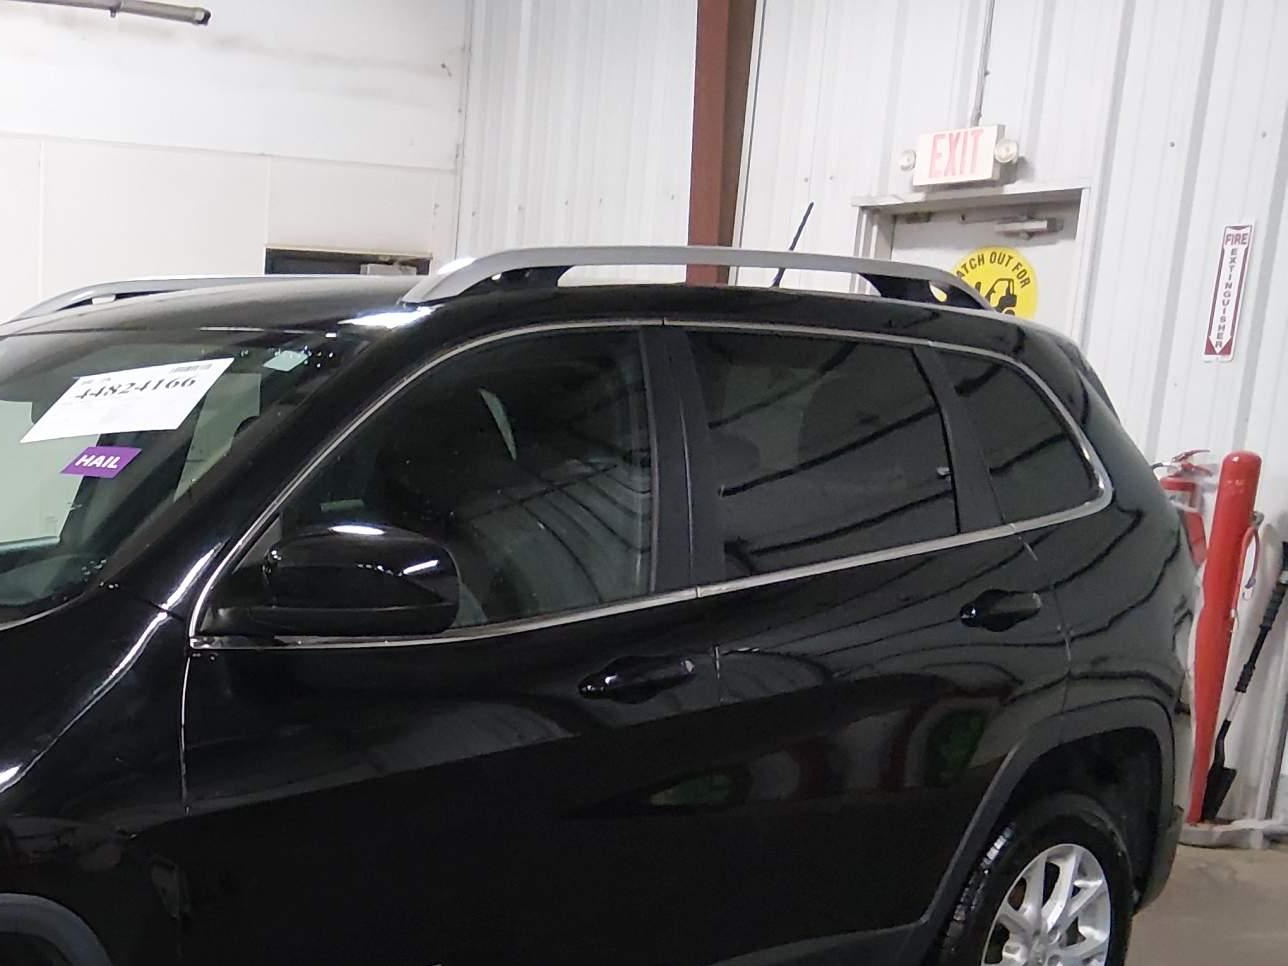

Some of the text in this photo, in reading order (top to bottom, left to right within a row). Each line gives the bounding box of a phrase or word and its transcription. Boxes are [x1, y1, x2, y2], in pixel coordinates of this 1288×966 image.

[928, 128, 984, 178] EXIT
[1225, 233, 1249, 246] FIRE
[955, 251, 1031, 289] ATCH OUT FOR
[1215, 248, 1237, 349] EXTINGUISHER
[75, 376, 197, 400] 44824166
[74, 454, 121, 470] HAIL
